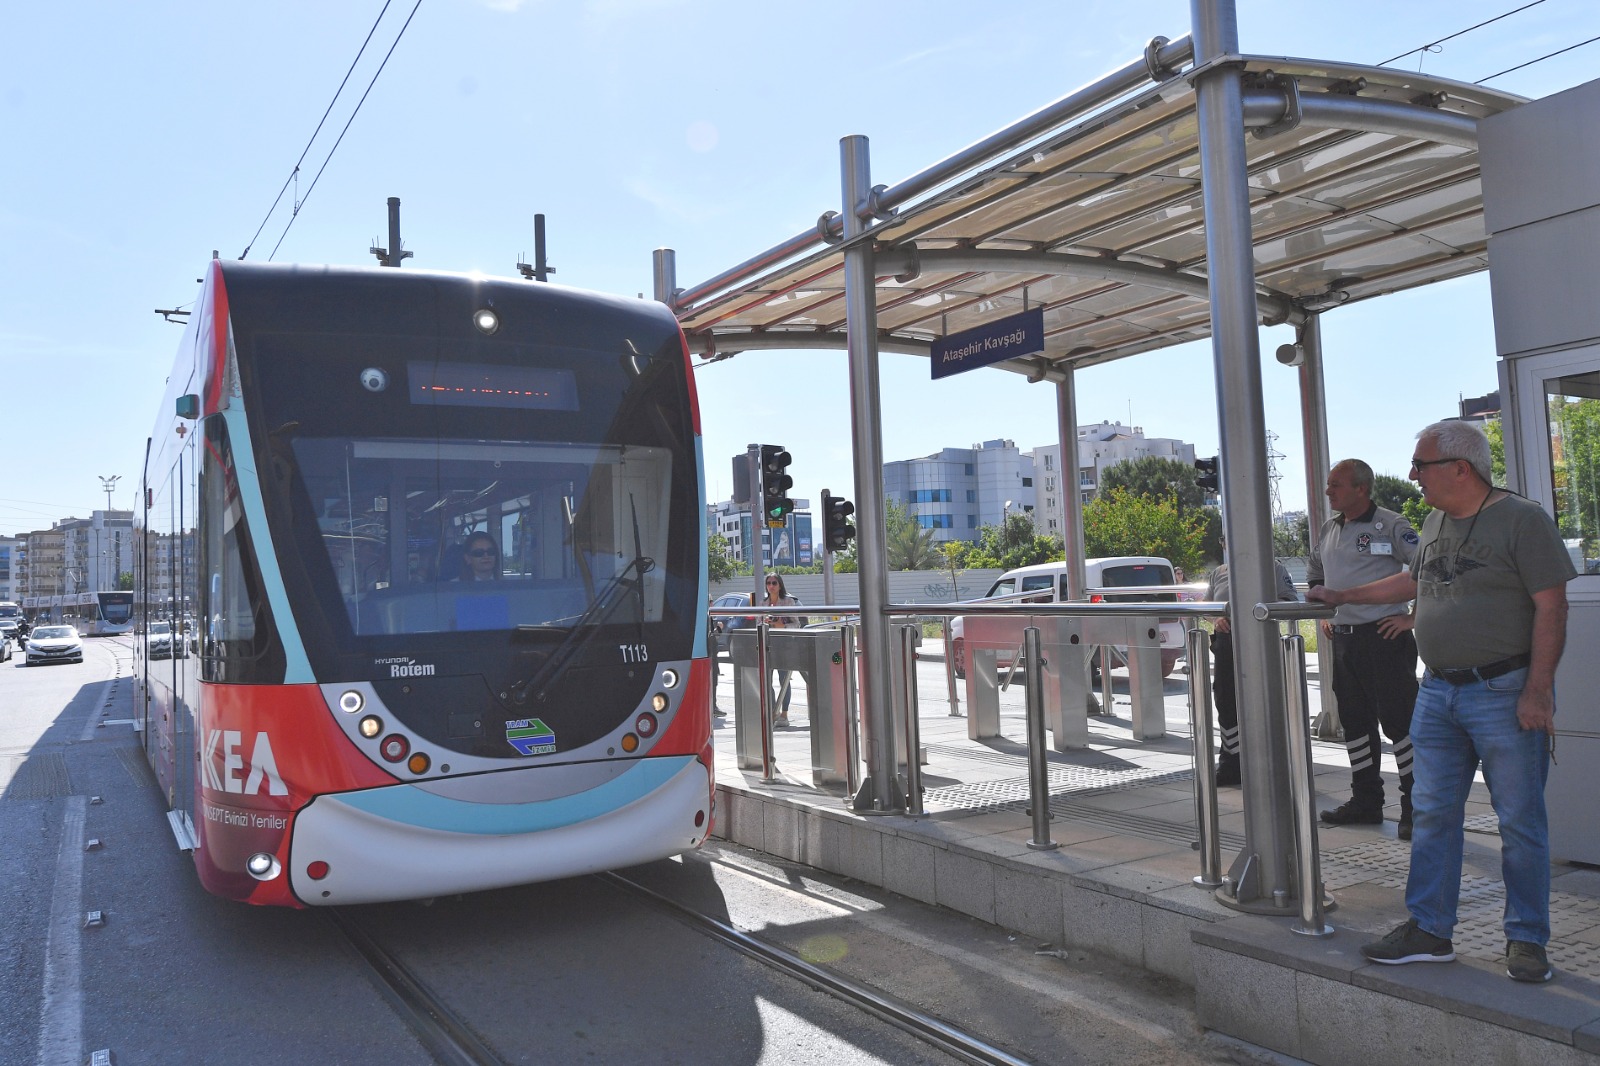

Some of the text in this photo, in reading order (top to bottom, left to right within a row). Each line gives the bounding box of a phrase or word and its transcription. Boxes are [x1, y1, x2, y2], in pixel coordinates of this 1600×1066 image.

[943, 329, 1025, 363] Ataşehir Kavşağı
[620, 644, 648, 663] T113
[391, 659, 435, 677] Rotem
[505, 719, 529, 728] TRAM
[224, 810, 248, 827] Evinizi
[250, 813, 287, 829] Yeniler
